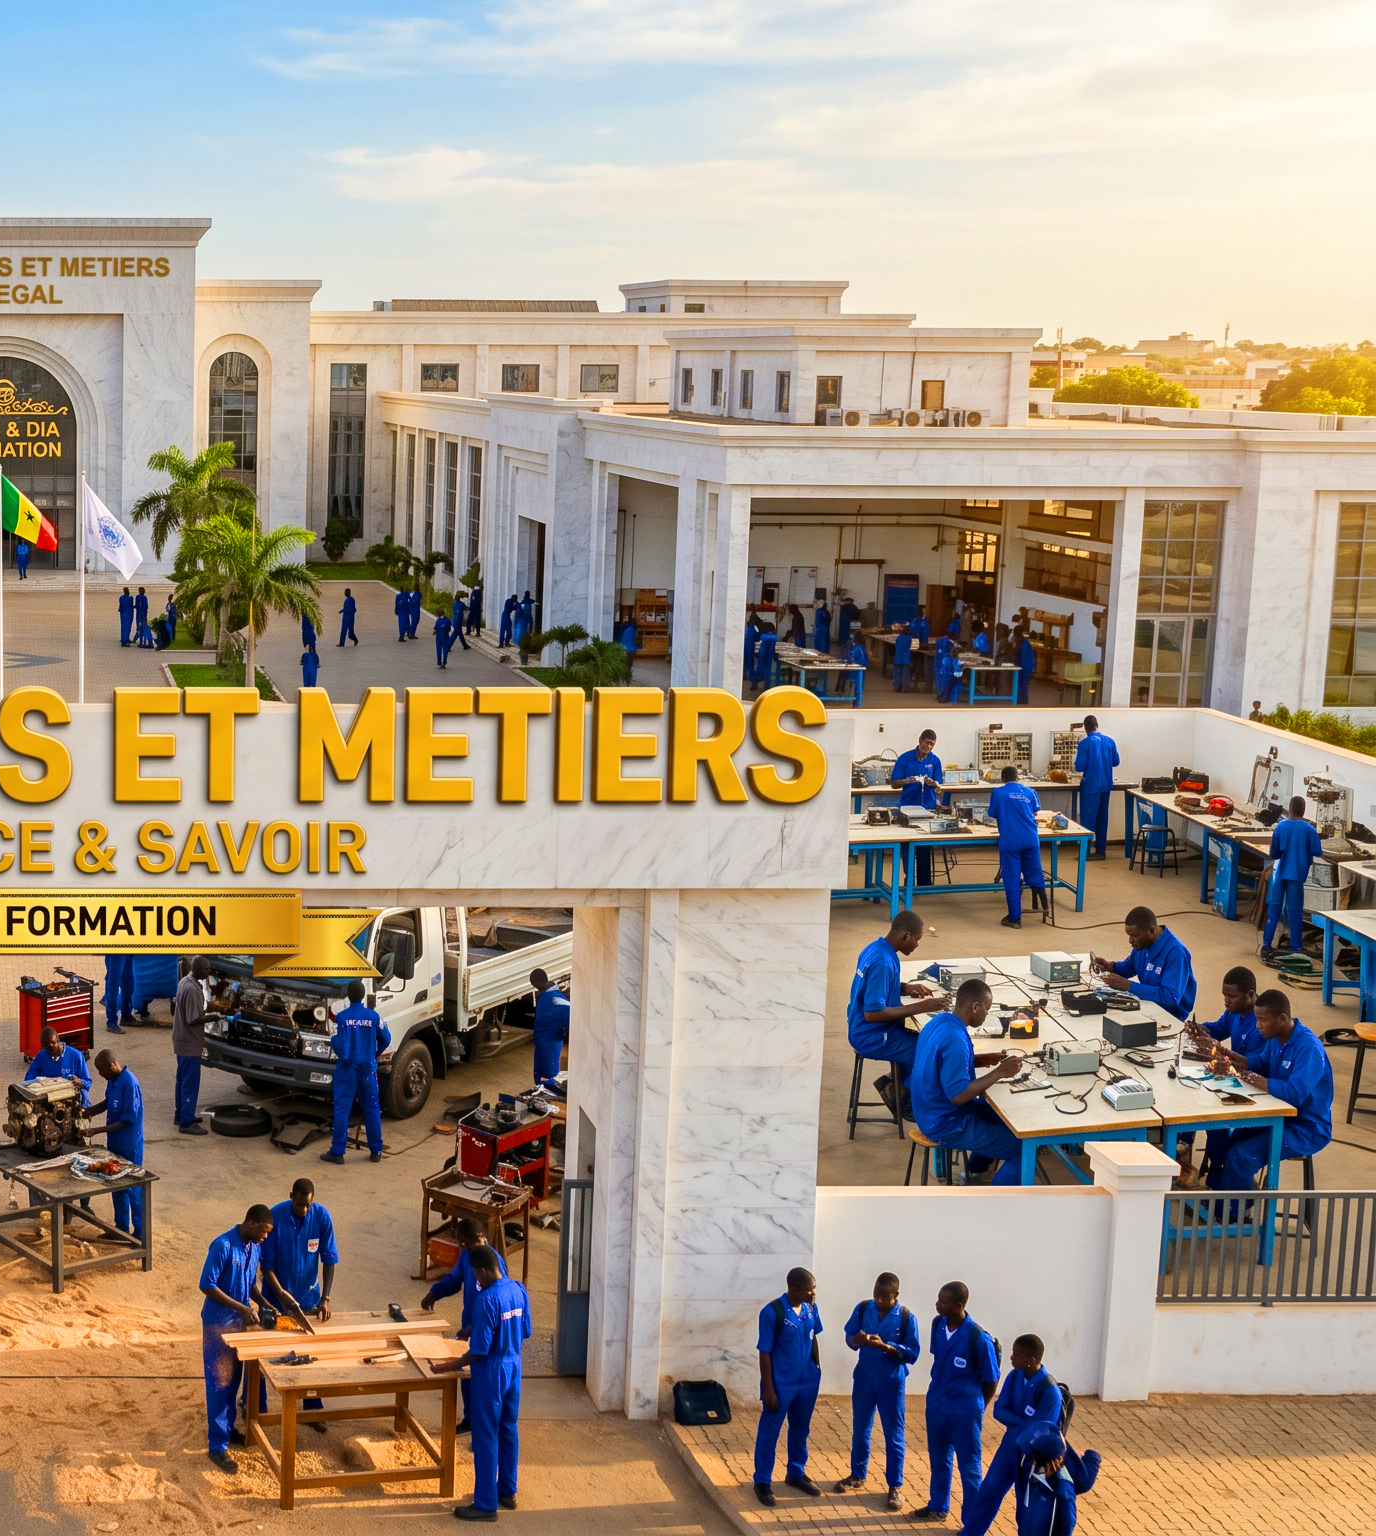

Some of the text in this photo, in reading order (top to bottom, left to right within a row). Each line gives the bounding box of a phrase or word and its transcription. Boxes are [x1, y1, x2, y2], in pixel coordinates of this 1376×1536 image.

[21, 257, 53, 277] ET
[60, 257, 170, 278] METIERS
[6, 421, 20, 438] &
[26, 421, 60, 438] DIA
[113, 687, 261, 802] ET
[297, 686, 828, 803] METIERS
[74, 820, 117, 874] &
[137, 820, 367, 874] SAVOIR
[6, 905, 216, 936] FORMATION
